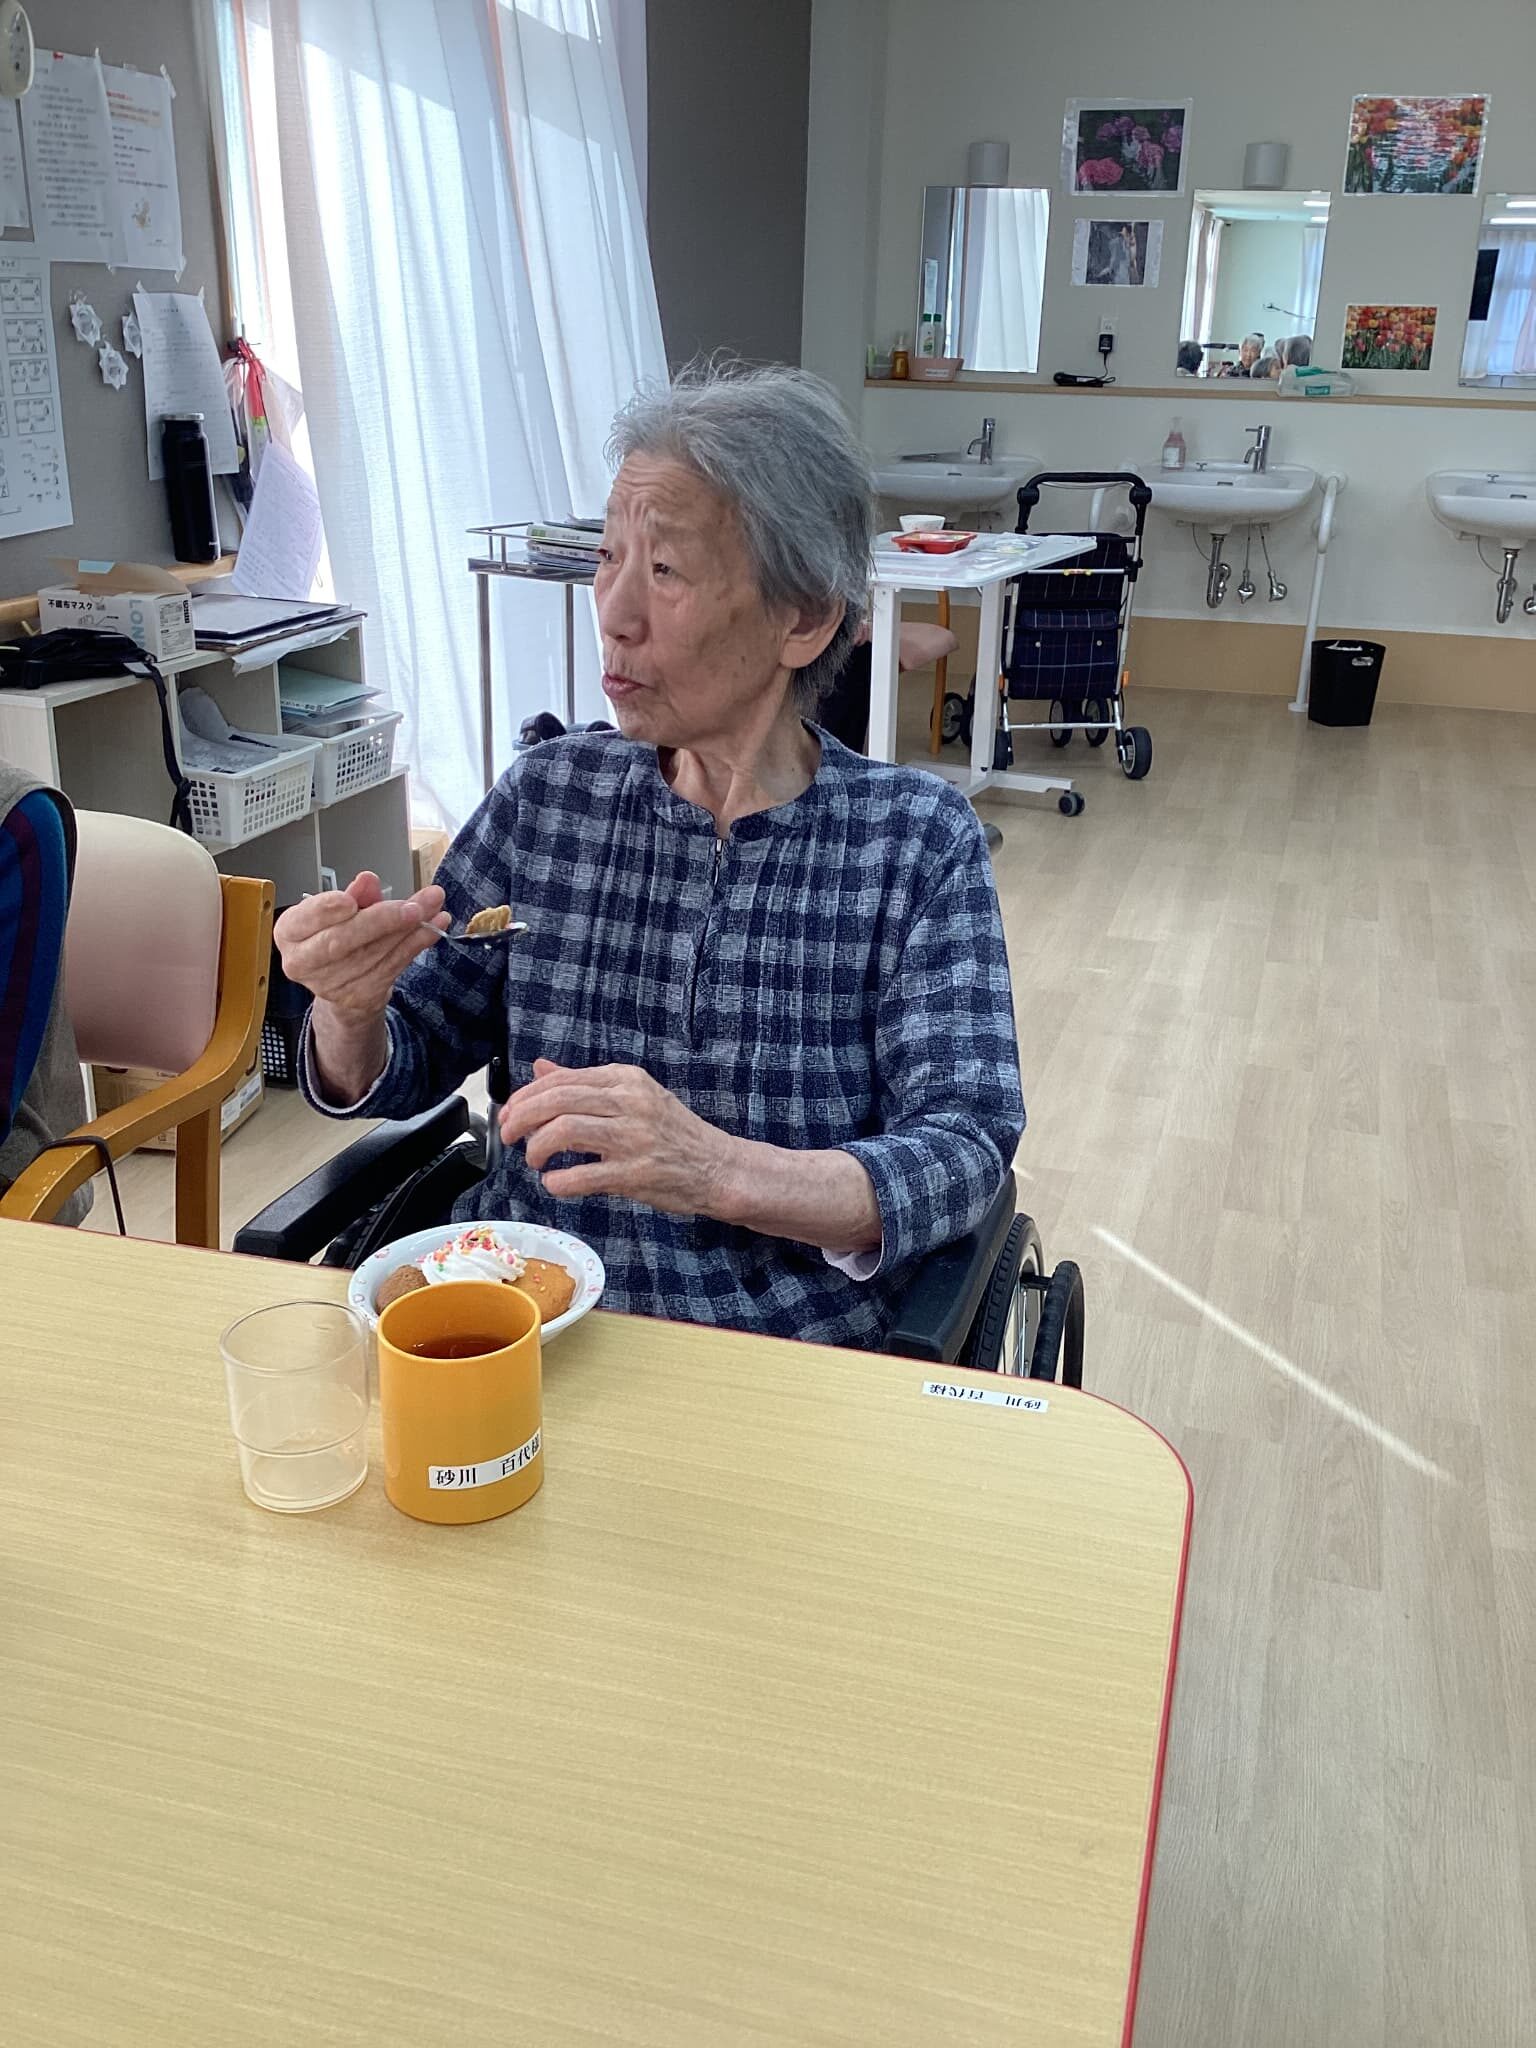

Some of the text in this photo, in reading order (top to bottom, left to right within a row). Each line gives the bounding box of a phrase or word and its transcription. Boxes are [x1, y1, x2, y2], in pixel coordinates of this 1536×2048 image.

[48, 599, 93, 611] 不織布マスク
[436, 1467, 477, 1487] 砂川
